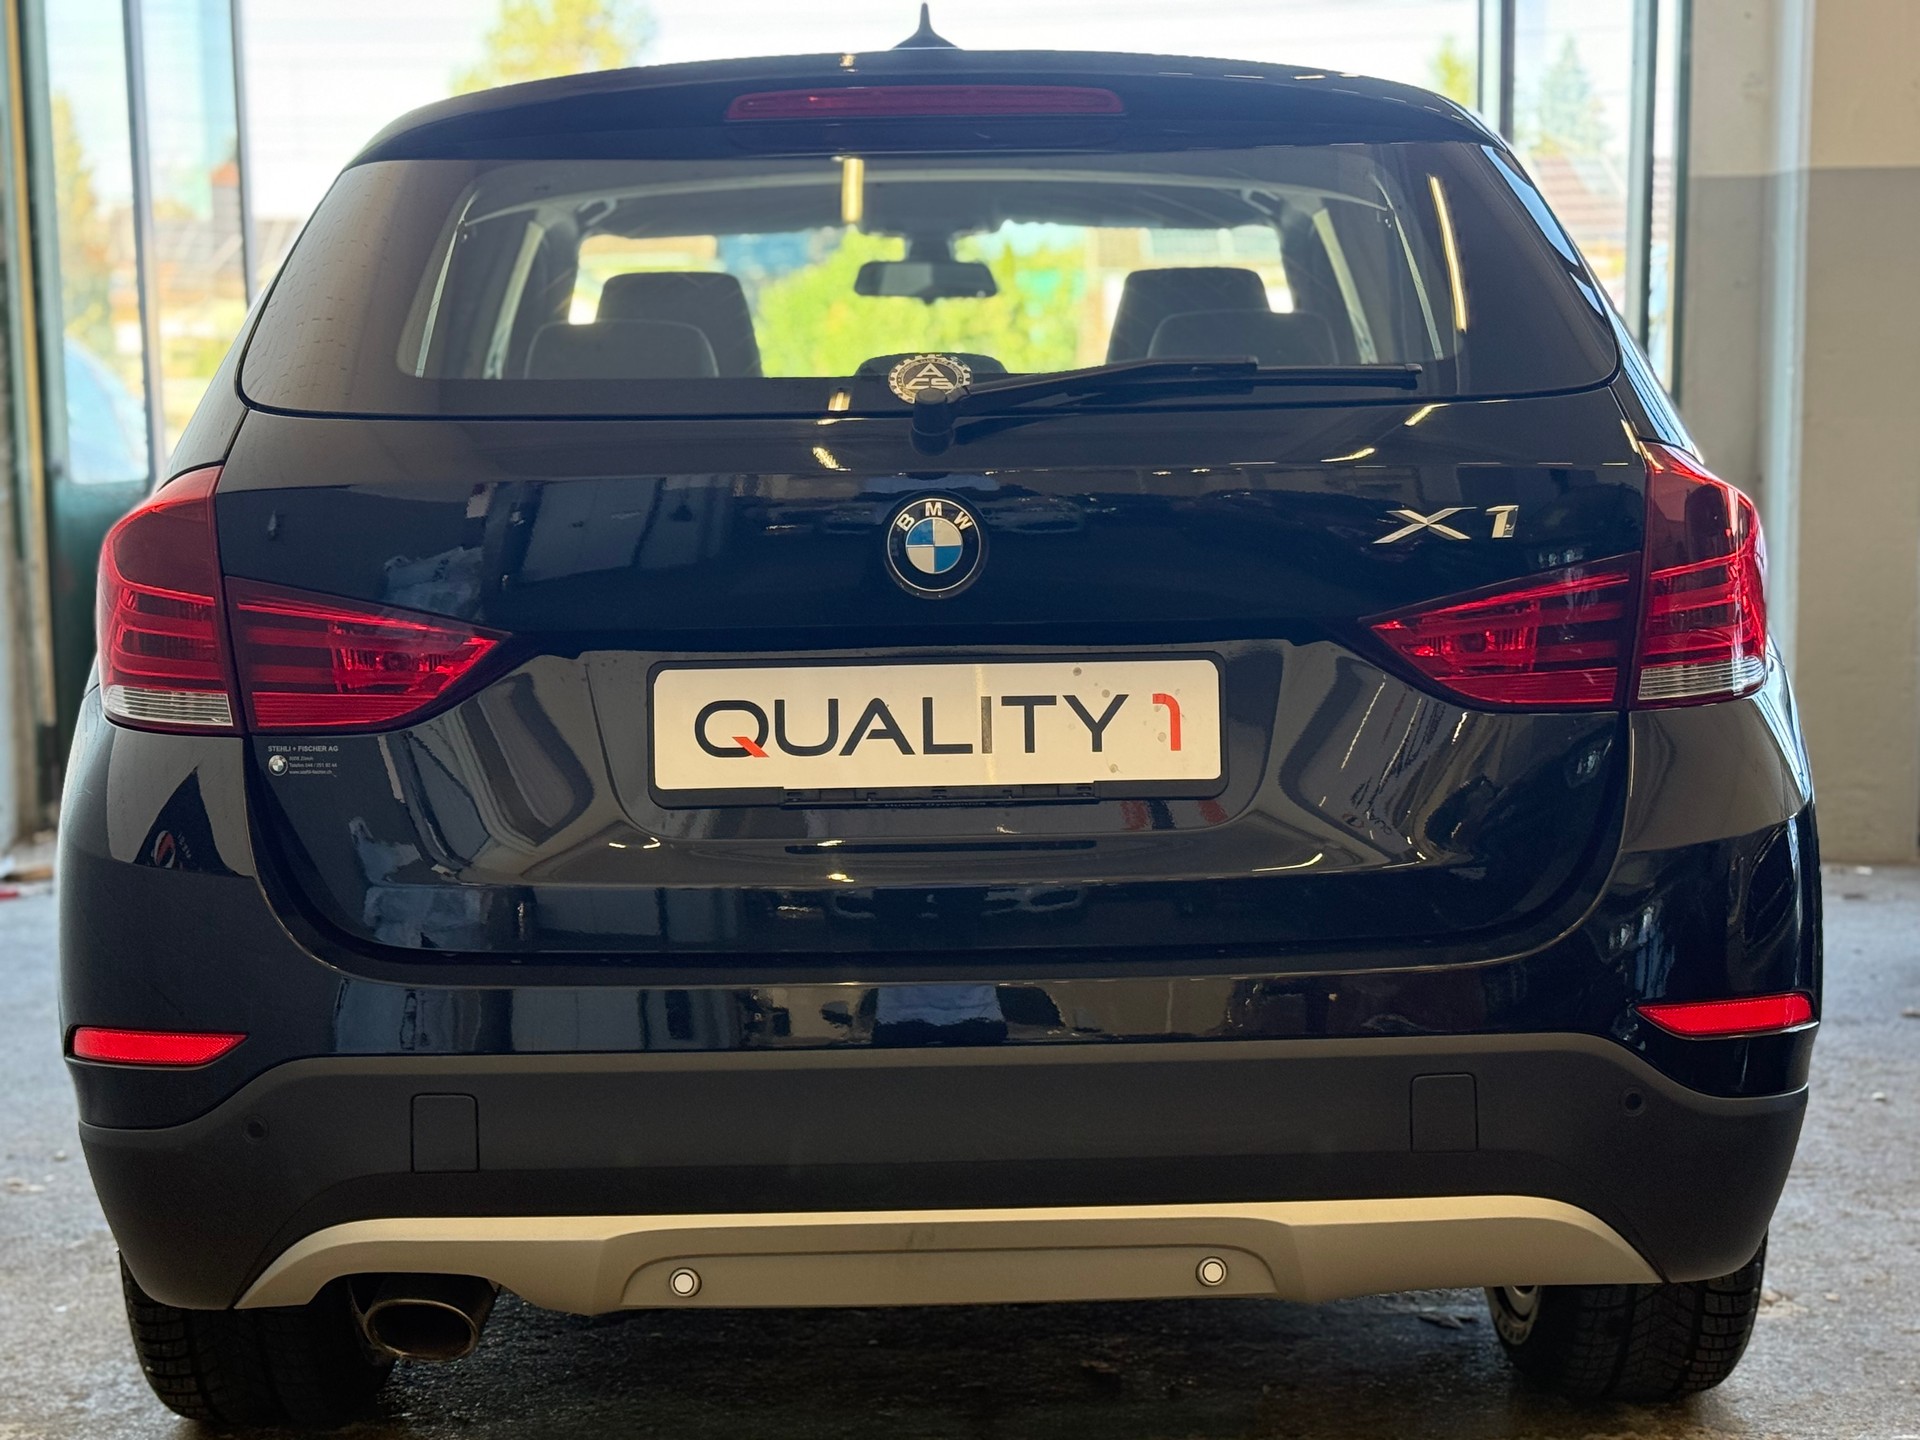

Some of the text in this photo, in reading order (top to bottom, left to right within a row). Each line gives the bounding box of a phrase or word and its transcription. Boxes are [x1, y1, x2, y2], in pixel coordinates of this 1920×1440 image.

[896, 501, 973, 531] BMW
[1372, 504, 1520, 544] X1
[694, 692, 1181, 759] QUALITY 1
